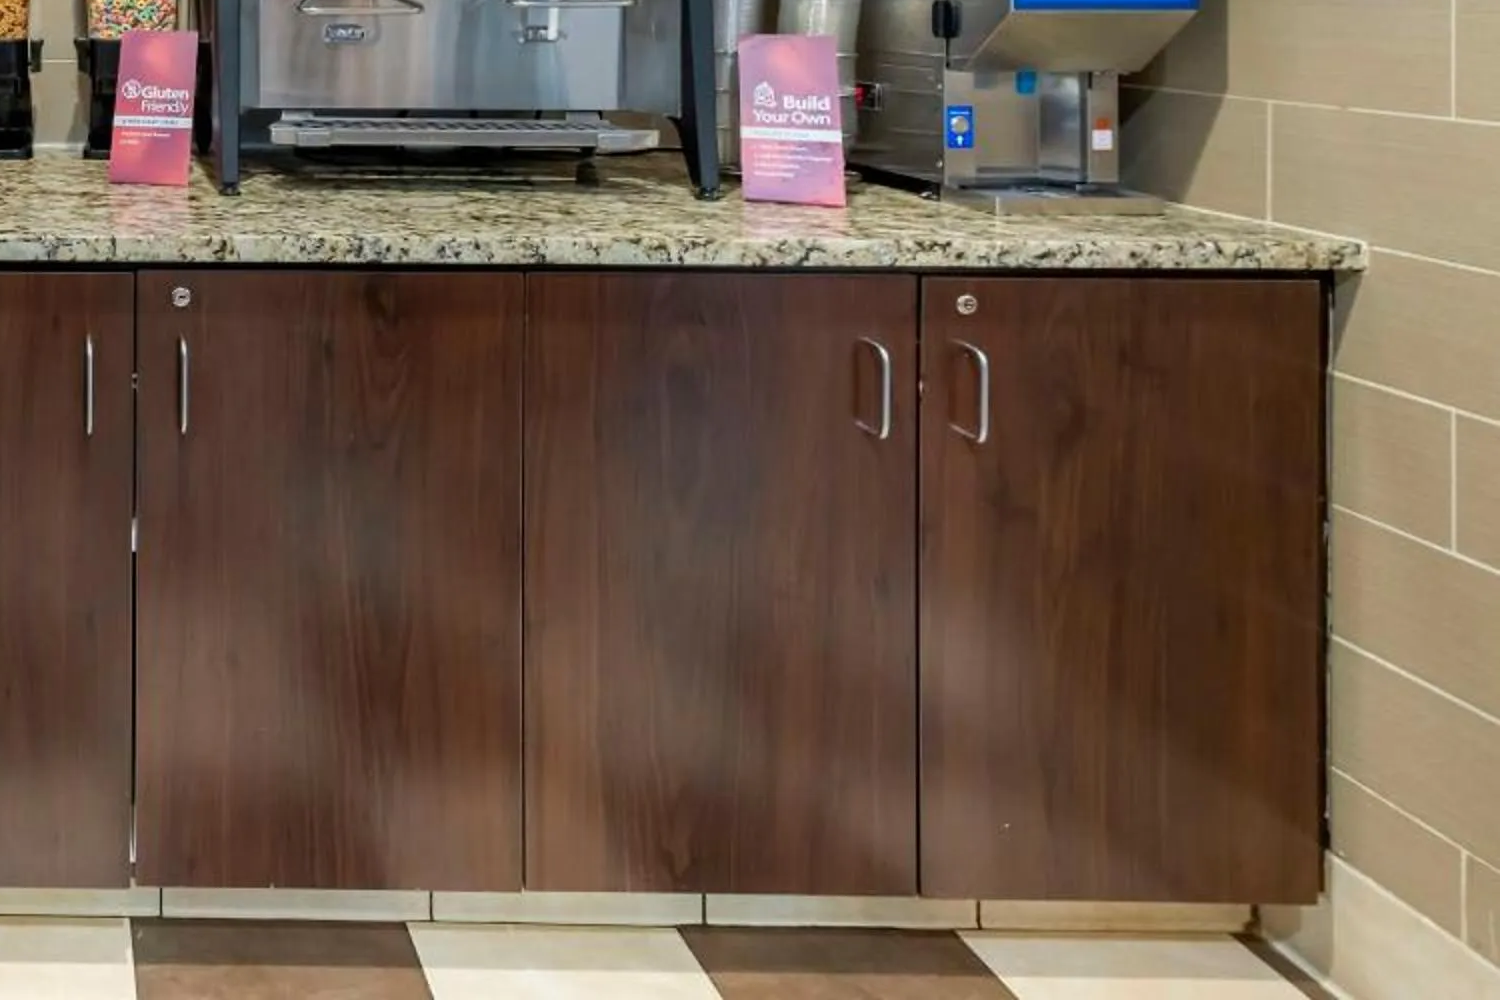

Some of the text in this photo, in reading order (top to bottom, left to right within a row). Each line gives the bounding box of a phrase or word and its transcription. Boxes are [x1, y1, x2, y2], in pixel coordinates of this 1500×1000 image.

[141, 86, 189, 100] Gluten
[141, 100, 189, 116] Friendly
[783, 95, 831, 111] Build
[752, 109, 832, 125] Your Own
